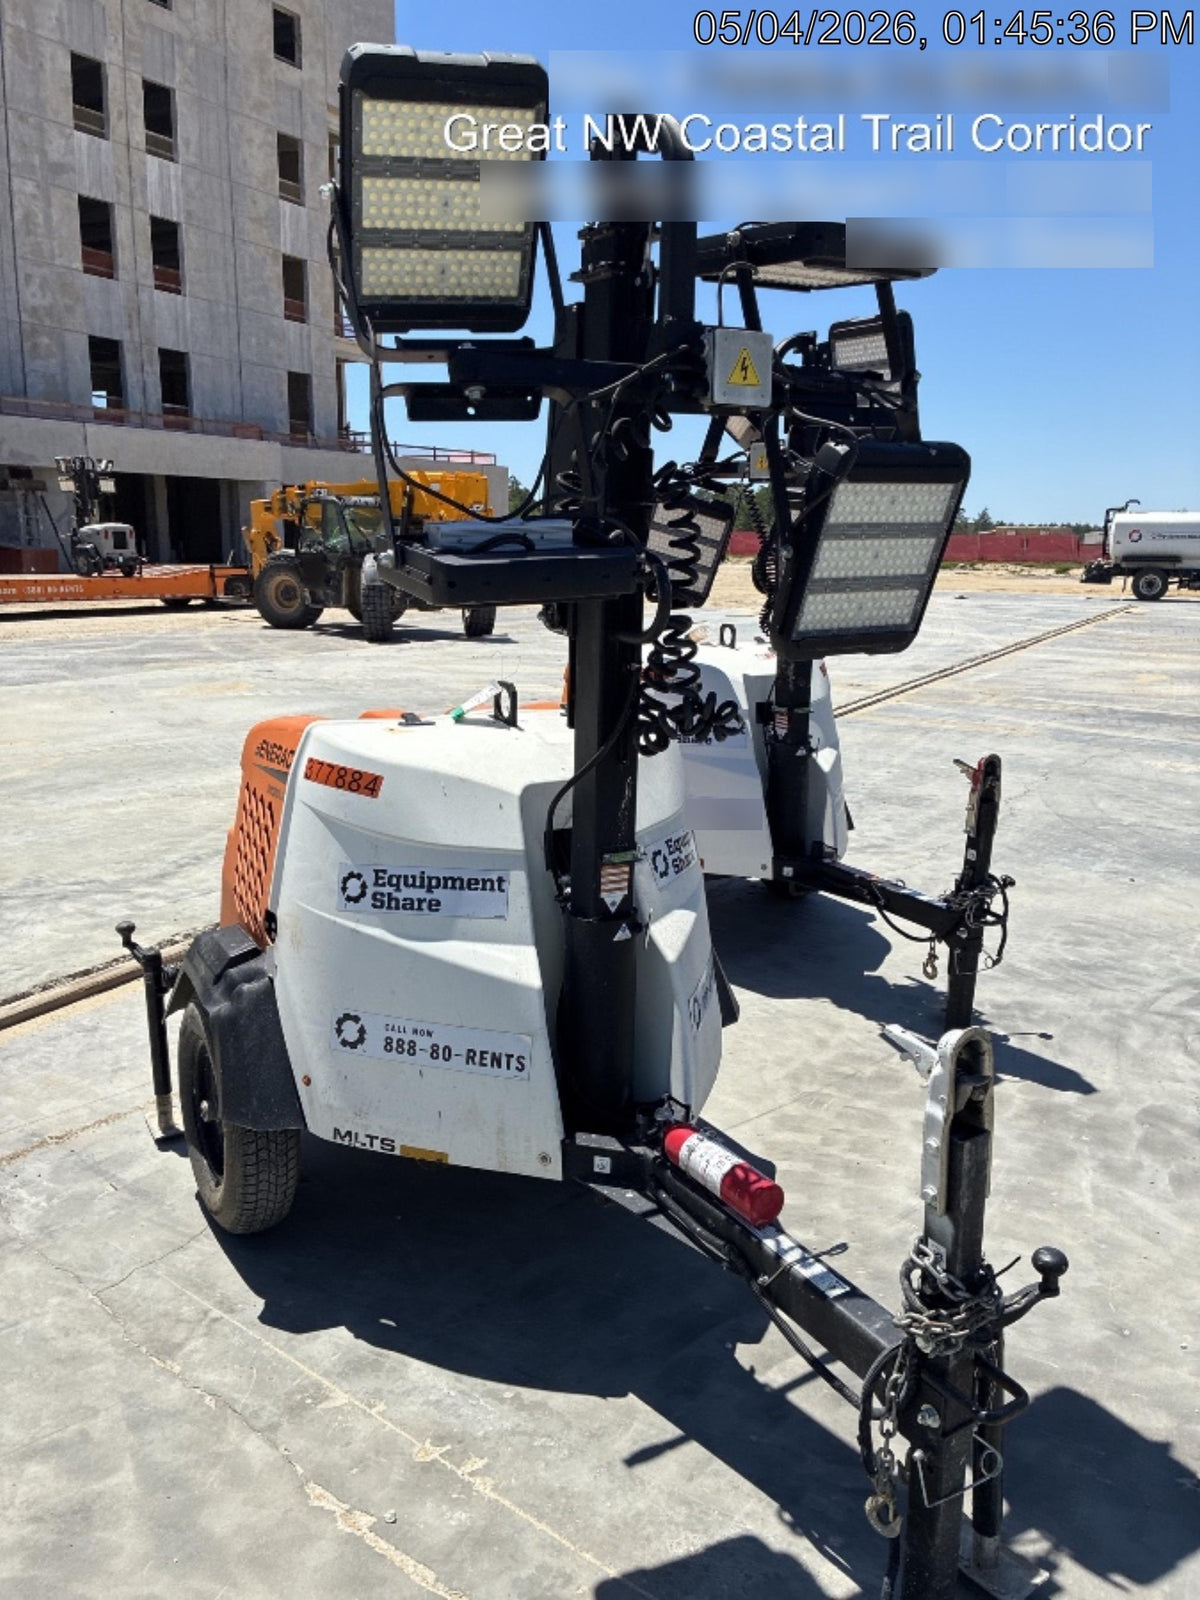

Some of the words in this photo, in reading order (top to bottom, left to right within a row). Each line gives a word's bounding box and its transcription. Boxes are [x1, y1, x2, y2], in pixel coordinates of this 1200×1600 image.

[372, 868, 506, 893] Equipment
[371, 891, 442, 912] Share
[385, 1023, 407, 1035] CALL
[412, 1028, 434, 1038] NOW
[384, 1036, 526, 1073] 888-80-RENTS
